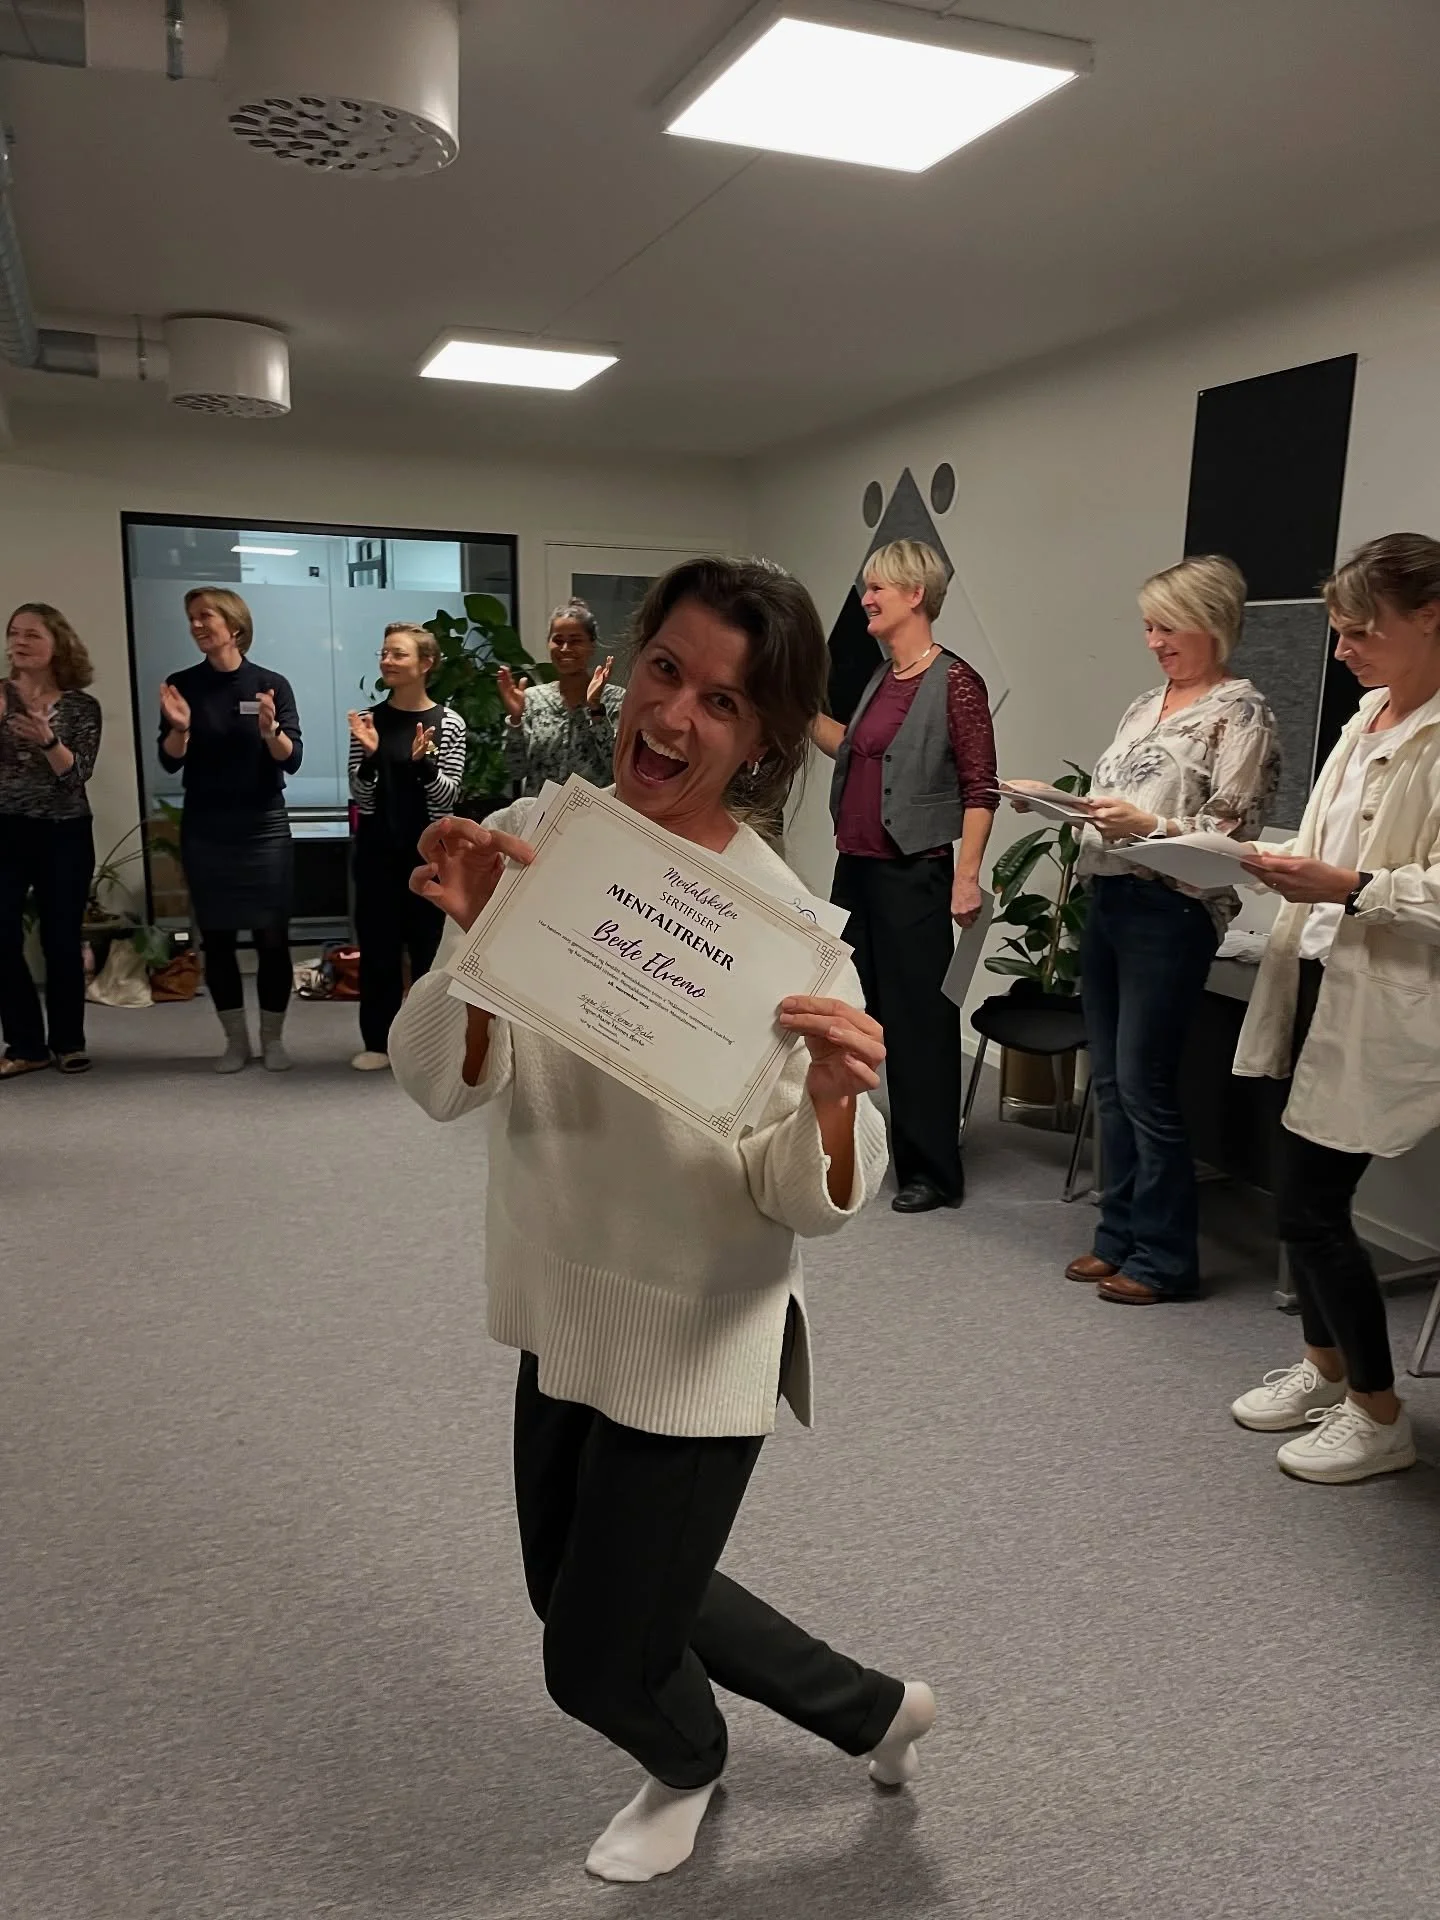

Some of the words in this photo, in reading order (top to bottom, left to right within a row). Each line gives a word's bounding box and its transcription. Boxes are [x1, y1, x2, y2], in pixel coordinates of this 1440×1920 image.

[659, 891, 722, 934] SERTIFISERT
[662, 867, 738, 920] Mentalskolen
[590, 919, 643, 961] Bente
[641, 952, 706, 998] Elvemo
[606, 883, 734, 972] MENTALTRENER
